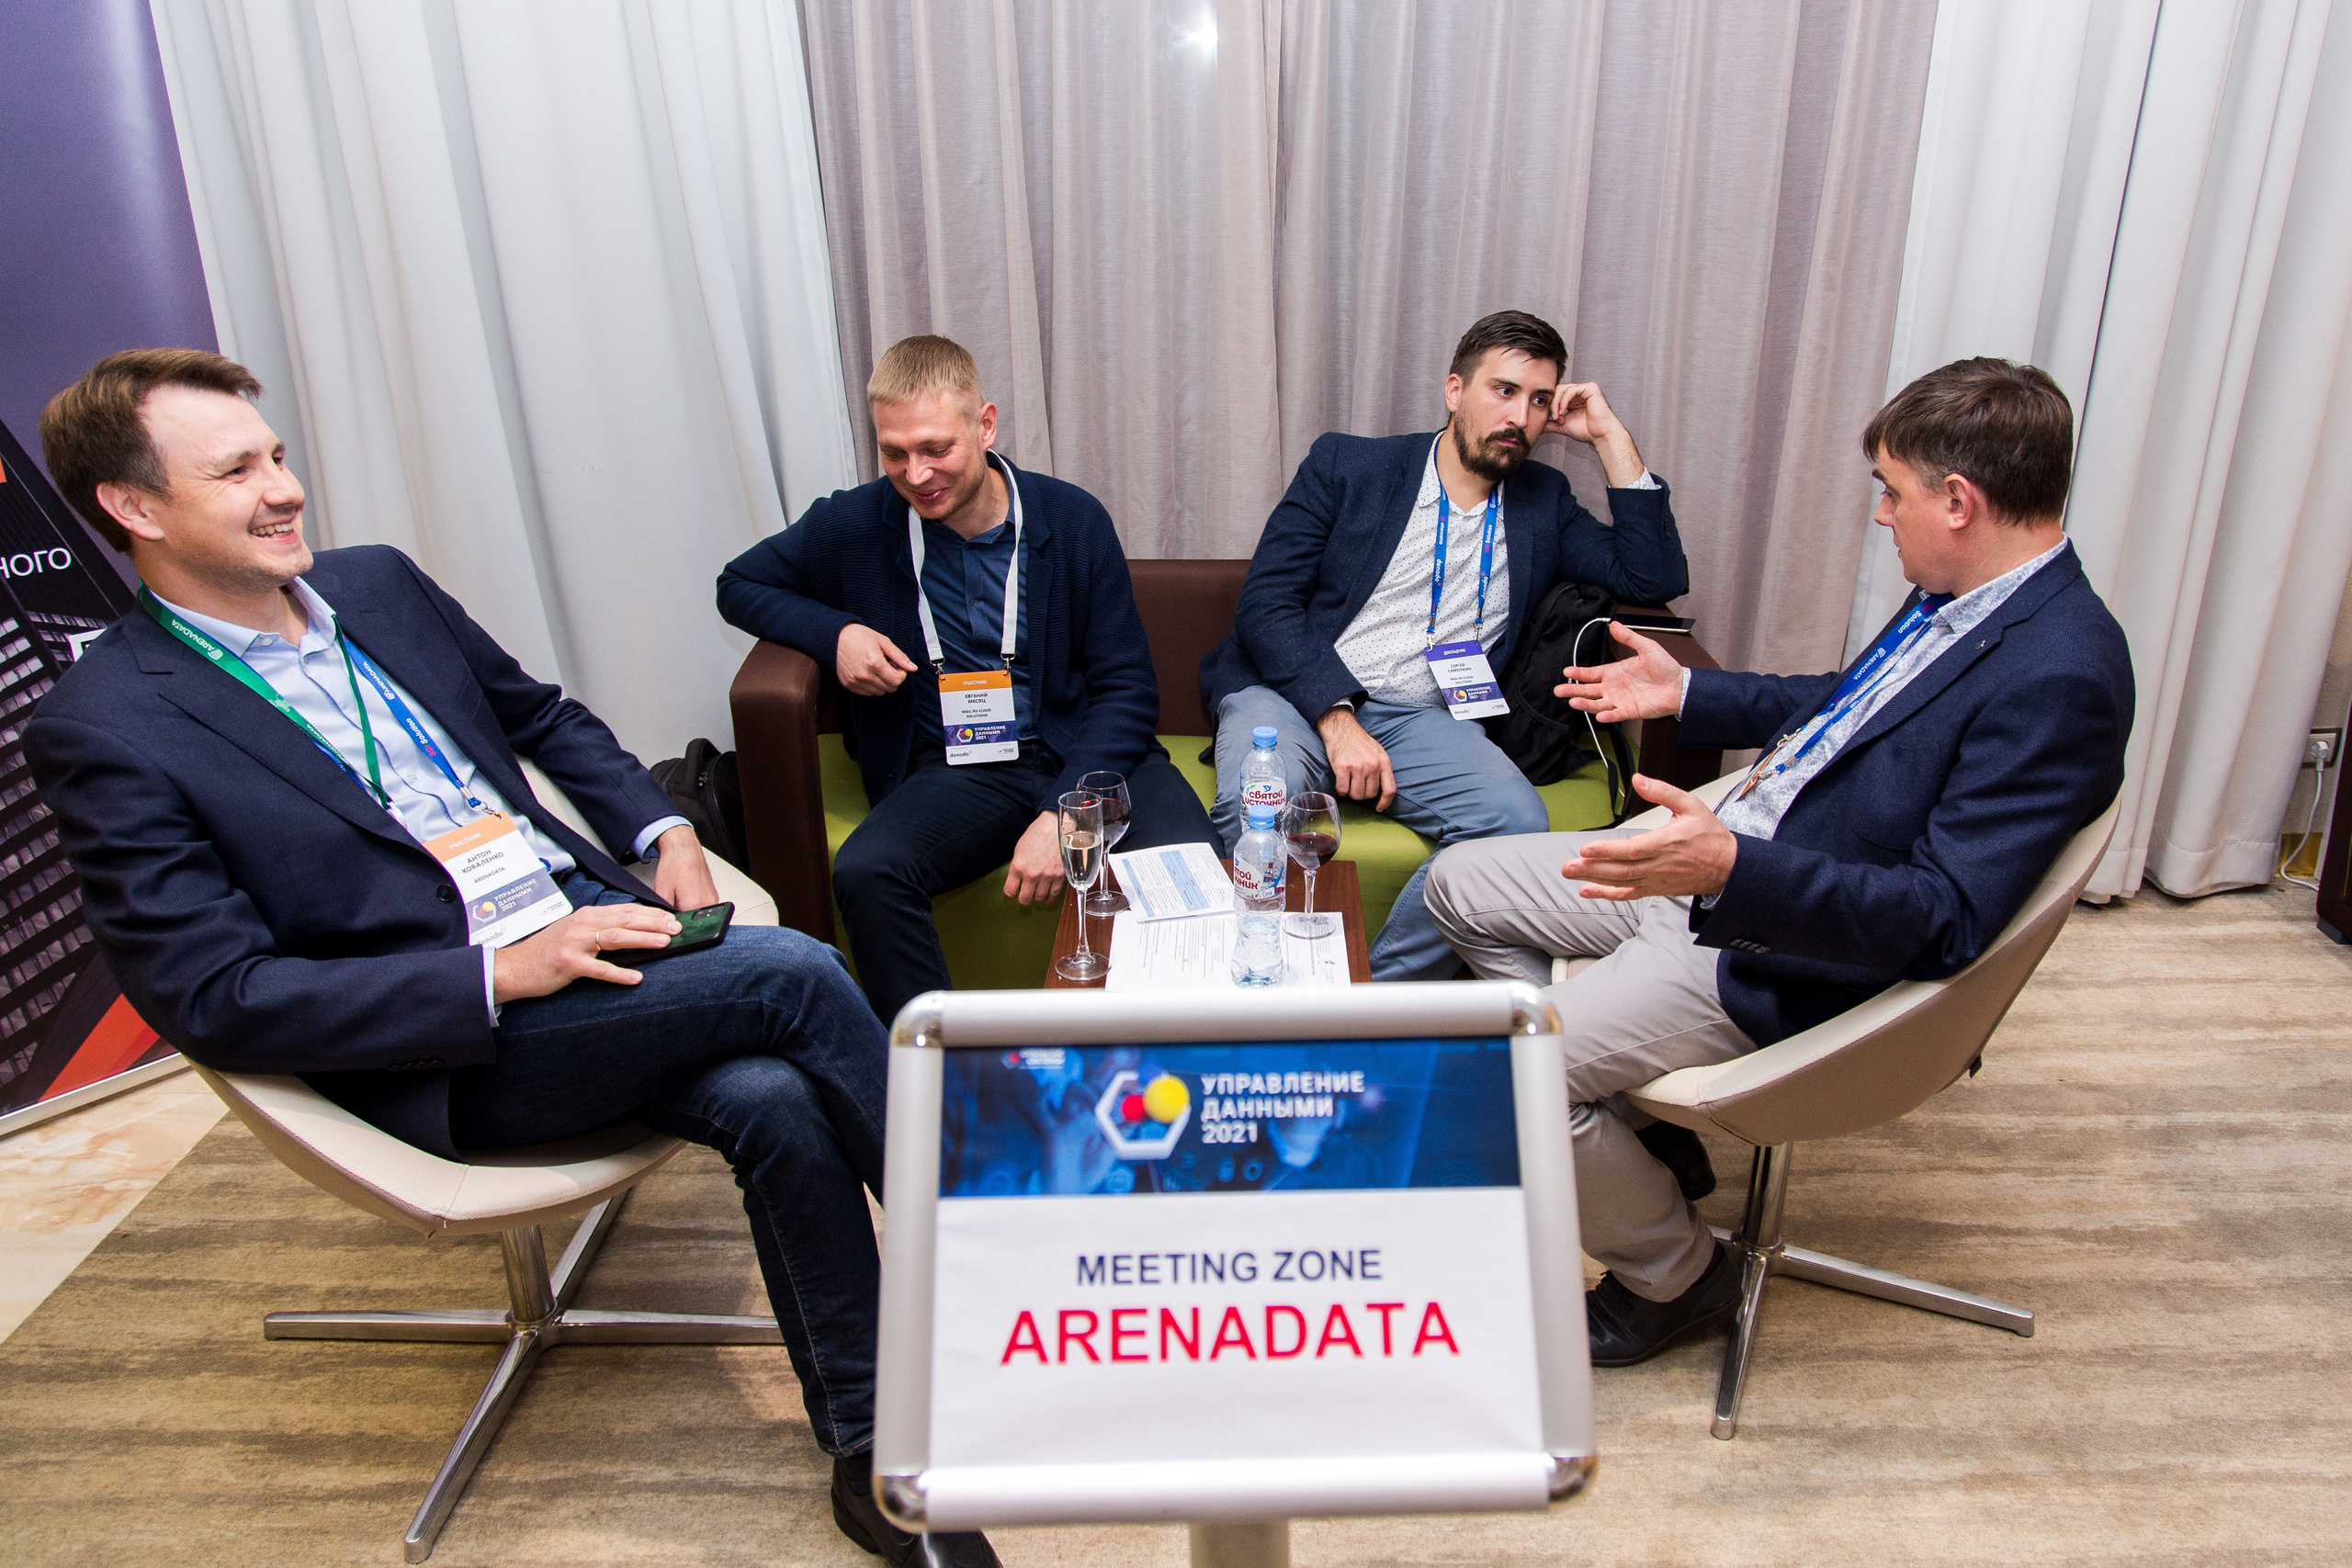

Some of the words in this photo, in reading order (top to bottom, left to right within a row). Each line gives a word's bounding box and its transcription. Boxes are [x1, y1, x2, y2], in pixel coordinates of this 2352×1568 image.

[1485, 525, 1493, 544] Solution
[1434, 558, 1443, 582] denodo
[1897, 610, 1922, 634] Solution
[172, 619, 215, 651] ARENADATA
[362, 661, 391, 694] ARENADATA
[1853, 652, 1879, 680] ARENADATA
[405, 717, 428, 745] Solution
[424, 744, 437, 757] SDI
[447, 832, 482, 851] УЧАСТНИК
[461, 852, 504, 874] КОВАЛЕНКО
[467, 850, 492, 864] АНТОН
[473, 866, 506, 884] ARENADATA
[493, 878, 537, 902] УПРАВЛЕНИЕ
[497, 887, 533, 908] ДАННЫМИ
[500, 901, 517, 912] 2021
[476, 931, 504, 945] denodo
[1201, 1070, 1365, 1096] УПРАВЛЕНИЕ
[1201, 1095, 1334, 1123] ДАННЫМИ
[1201, 1120, 1259, 1144] 2021
[1076, 1251, 1259, 1286] MEETING
[1272, 1248, 1383, 1282] ZONE
[1000, 1301, 1461, 1367] ARENADATA
